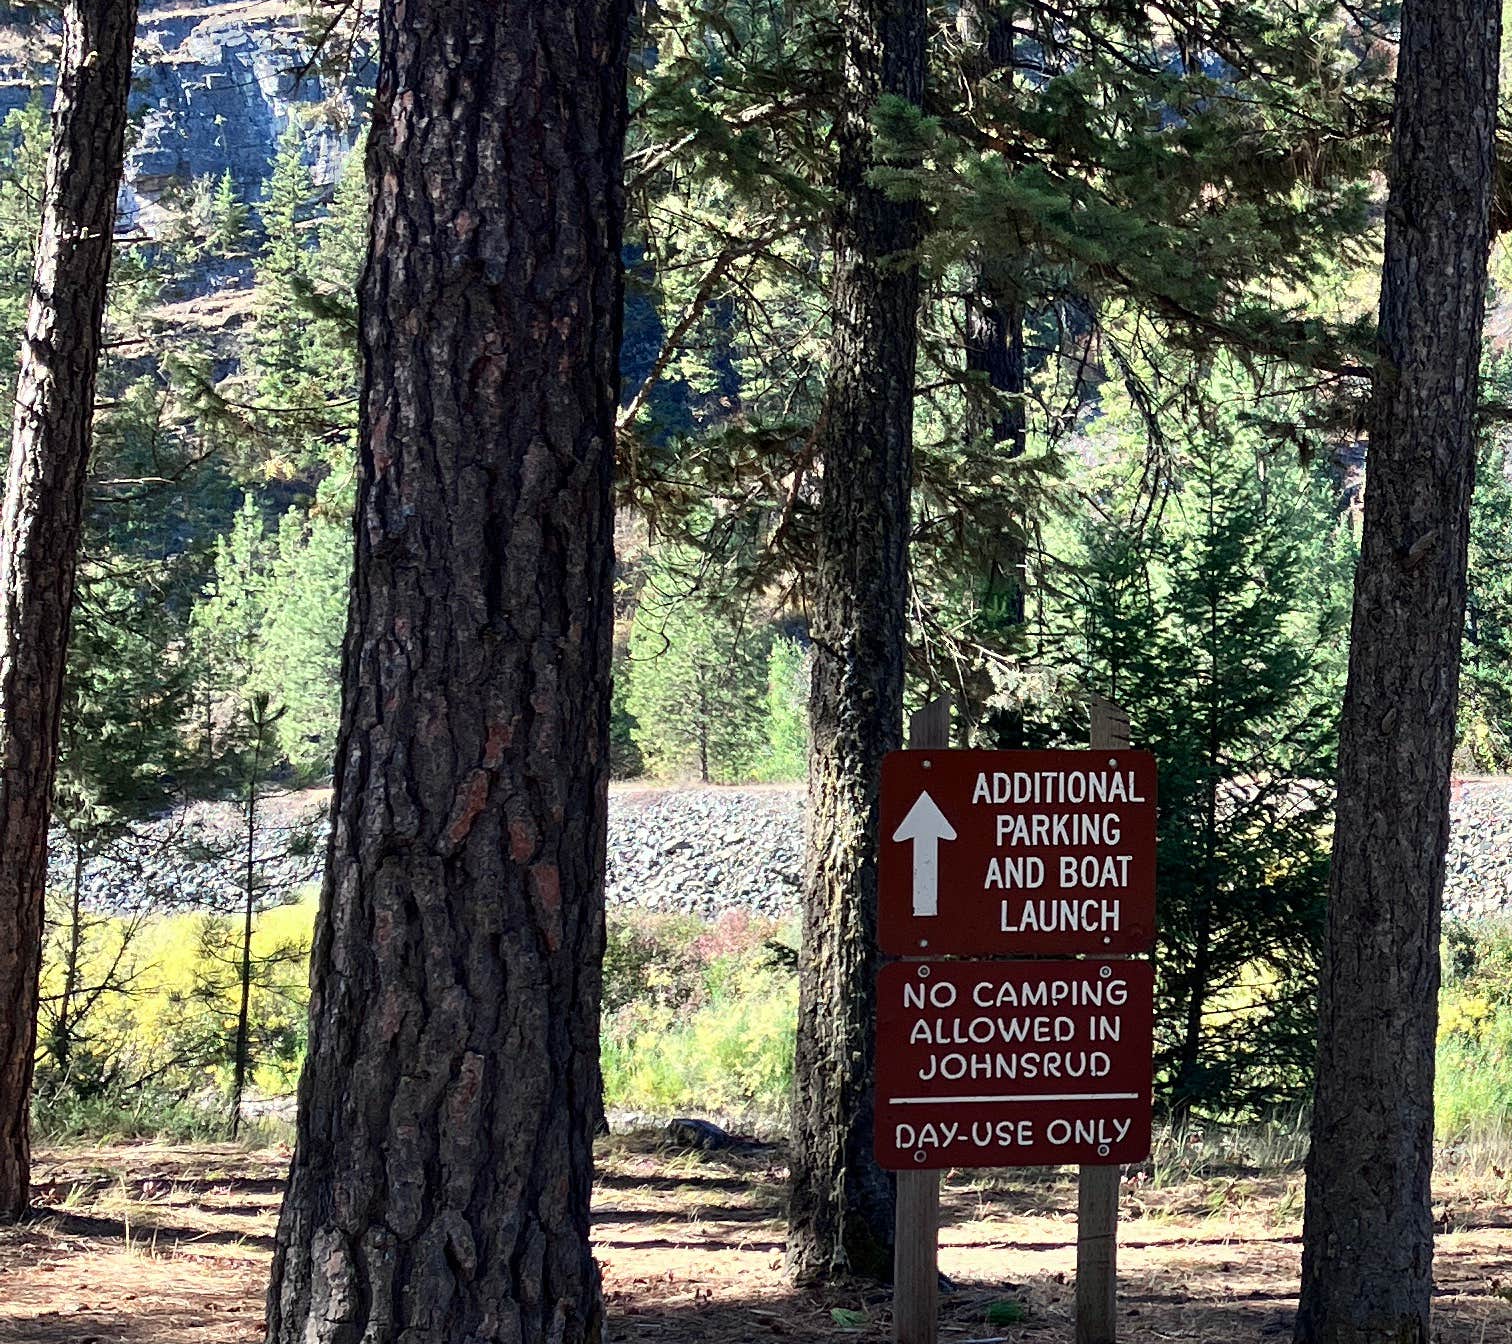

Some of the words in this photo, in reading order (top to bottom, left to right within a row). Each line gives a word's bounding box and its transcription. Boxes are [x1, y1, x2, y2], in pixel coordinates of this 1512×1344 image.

[972, 771, 1145, 805] ADDITIONAL
[996, 813, 1121, 846] PARKING
[984, 857, 1045, 889] AND
[1059, 855, 1132, 888] BOAT
[1001, 899, 1120, 932] LAUNCH
[904, 982, 957, 1009] NO
[973, 980, 1128, 1007] CAMPING
[910, 1016, 1075, 1045] ALLOWED
[1089, 1016, 1121, 1041] IN
[919, 1052, 1111, 1081] JOHNSRUD
[895, 1120, 1034, 1150] DAY-USE
[1047, 1118, 1131, 1145] ONLY
